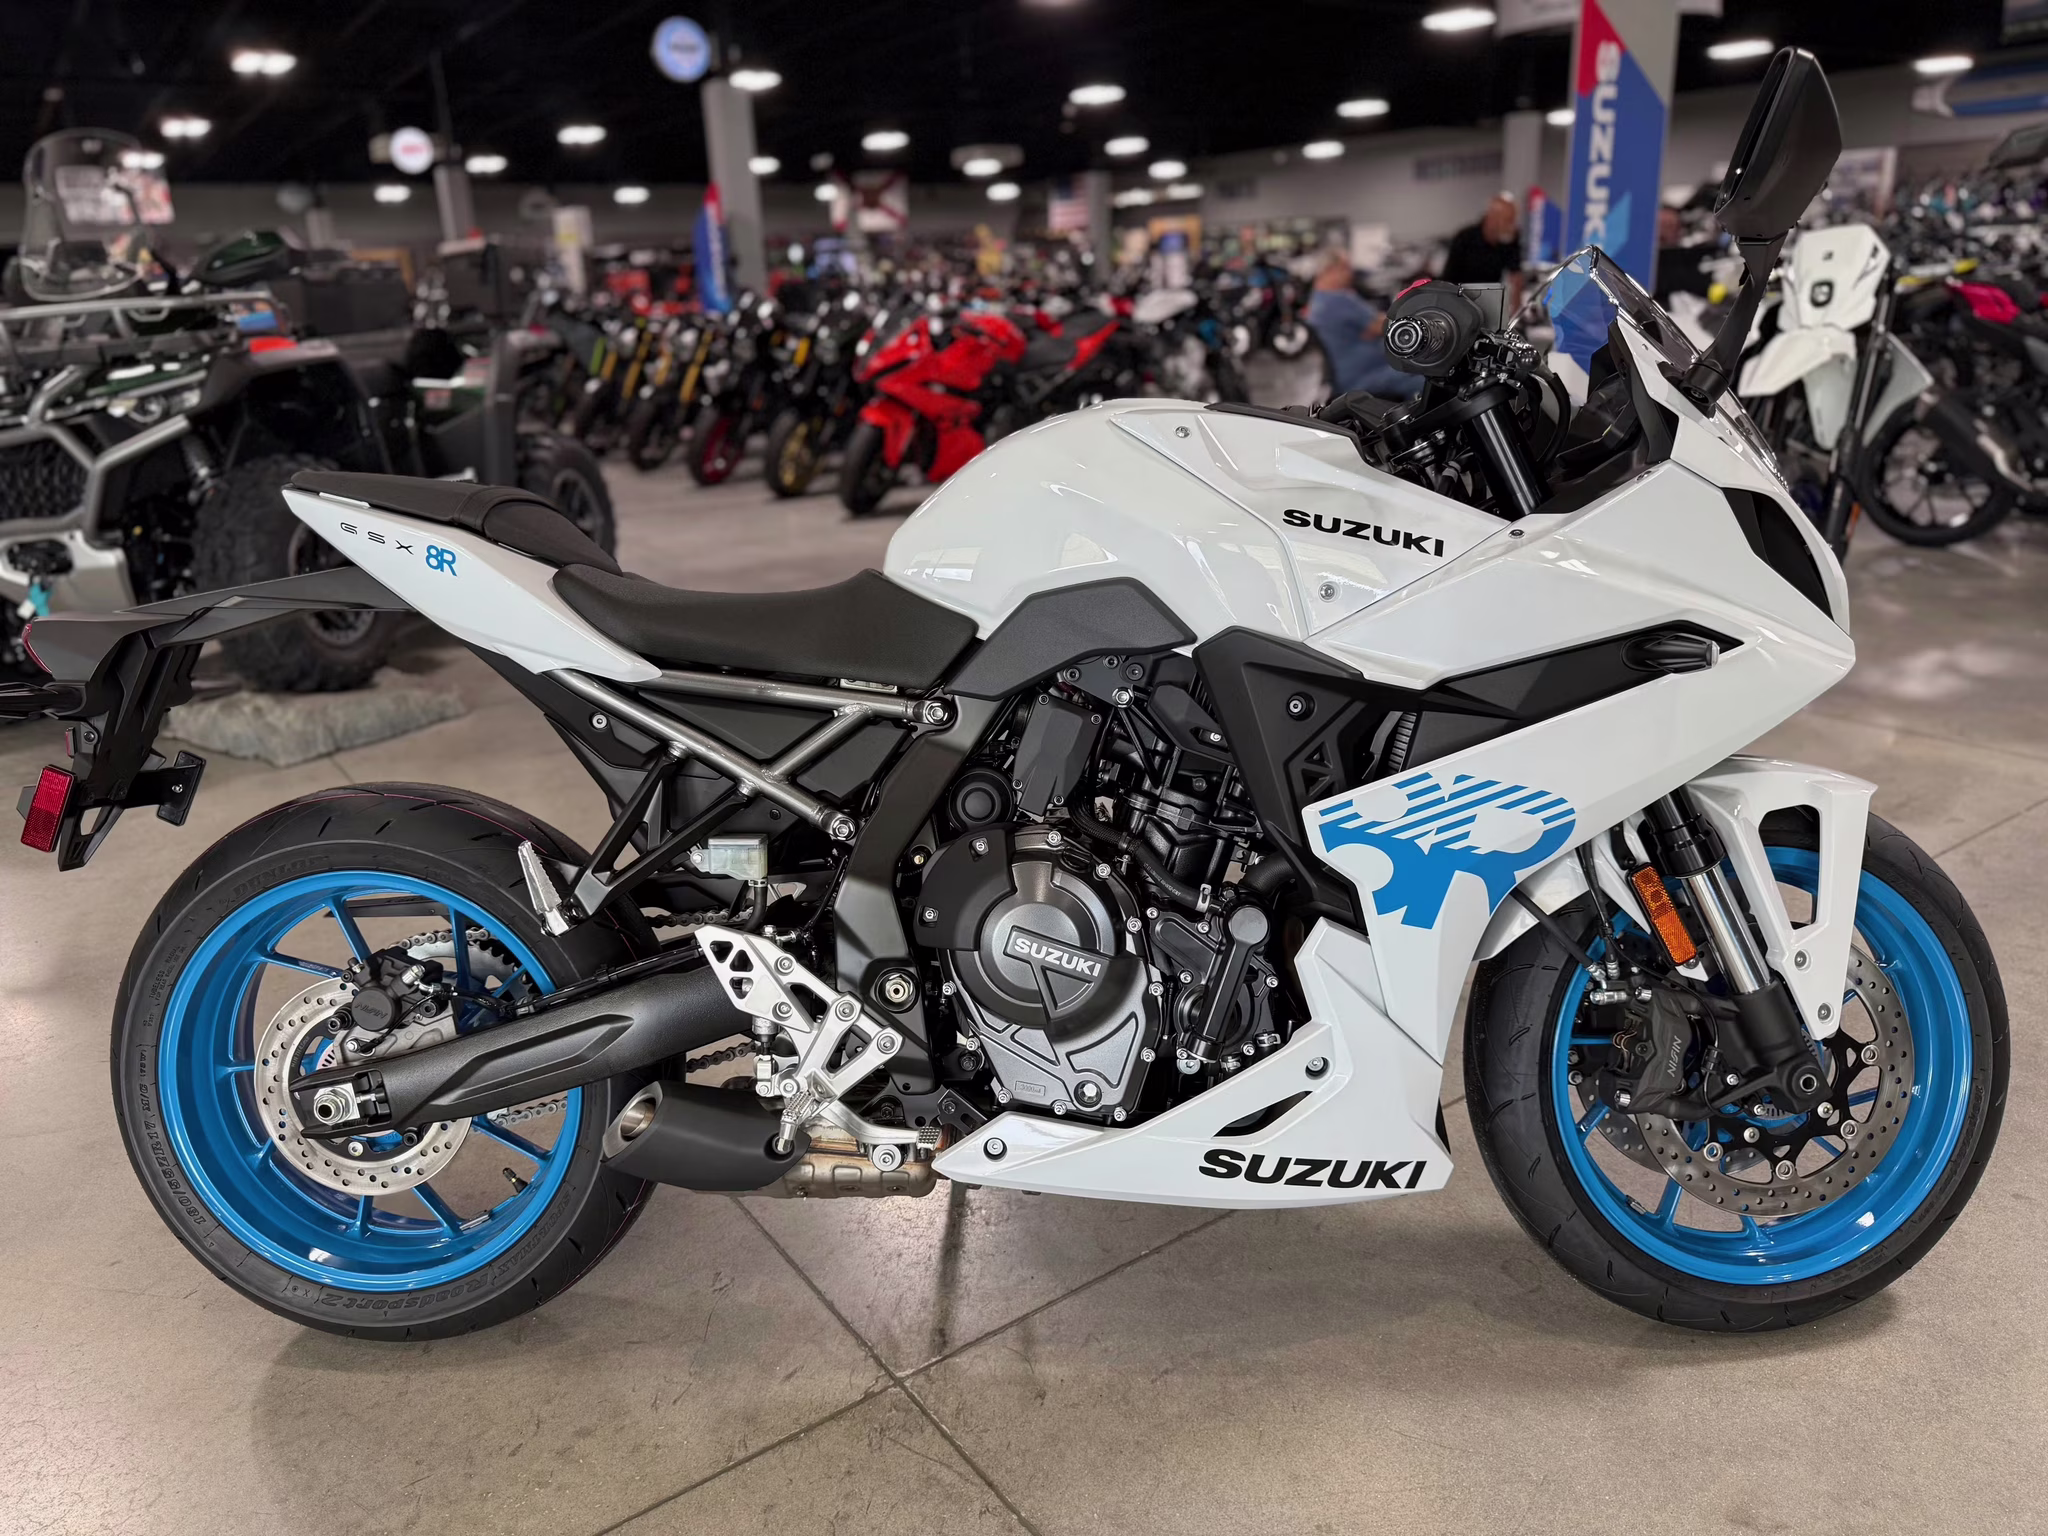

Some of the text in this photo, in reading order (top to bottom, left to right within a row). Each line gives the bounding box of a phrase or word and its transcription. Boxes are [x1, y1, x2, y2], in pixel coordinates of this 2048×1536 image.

[1583, 40, 1621, 249] SUZUK
[340, 522, 458, 577] GSX 8R
[1282, 509, 1444, 558] SUZUKI
[1014, 938, 1102, 977] SUZUKI
[354, 1002, 389, 1019] NISSIN
[1667, 1035, 1682, 1077] NISSIN
[144, 1121, 207, 1225] 180/55ZR17
[1198, 1149, 1428, 1189] SUZUKI
